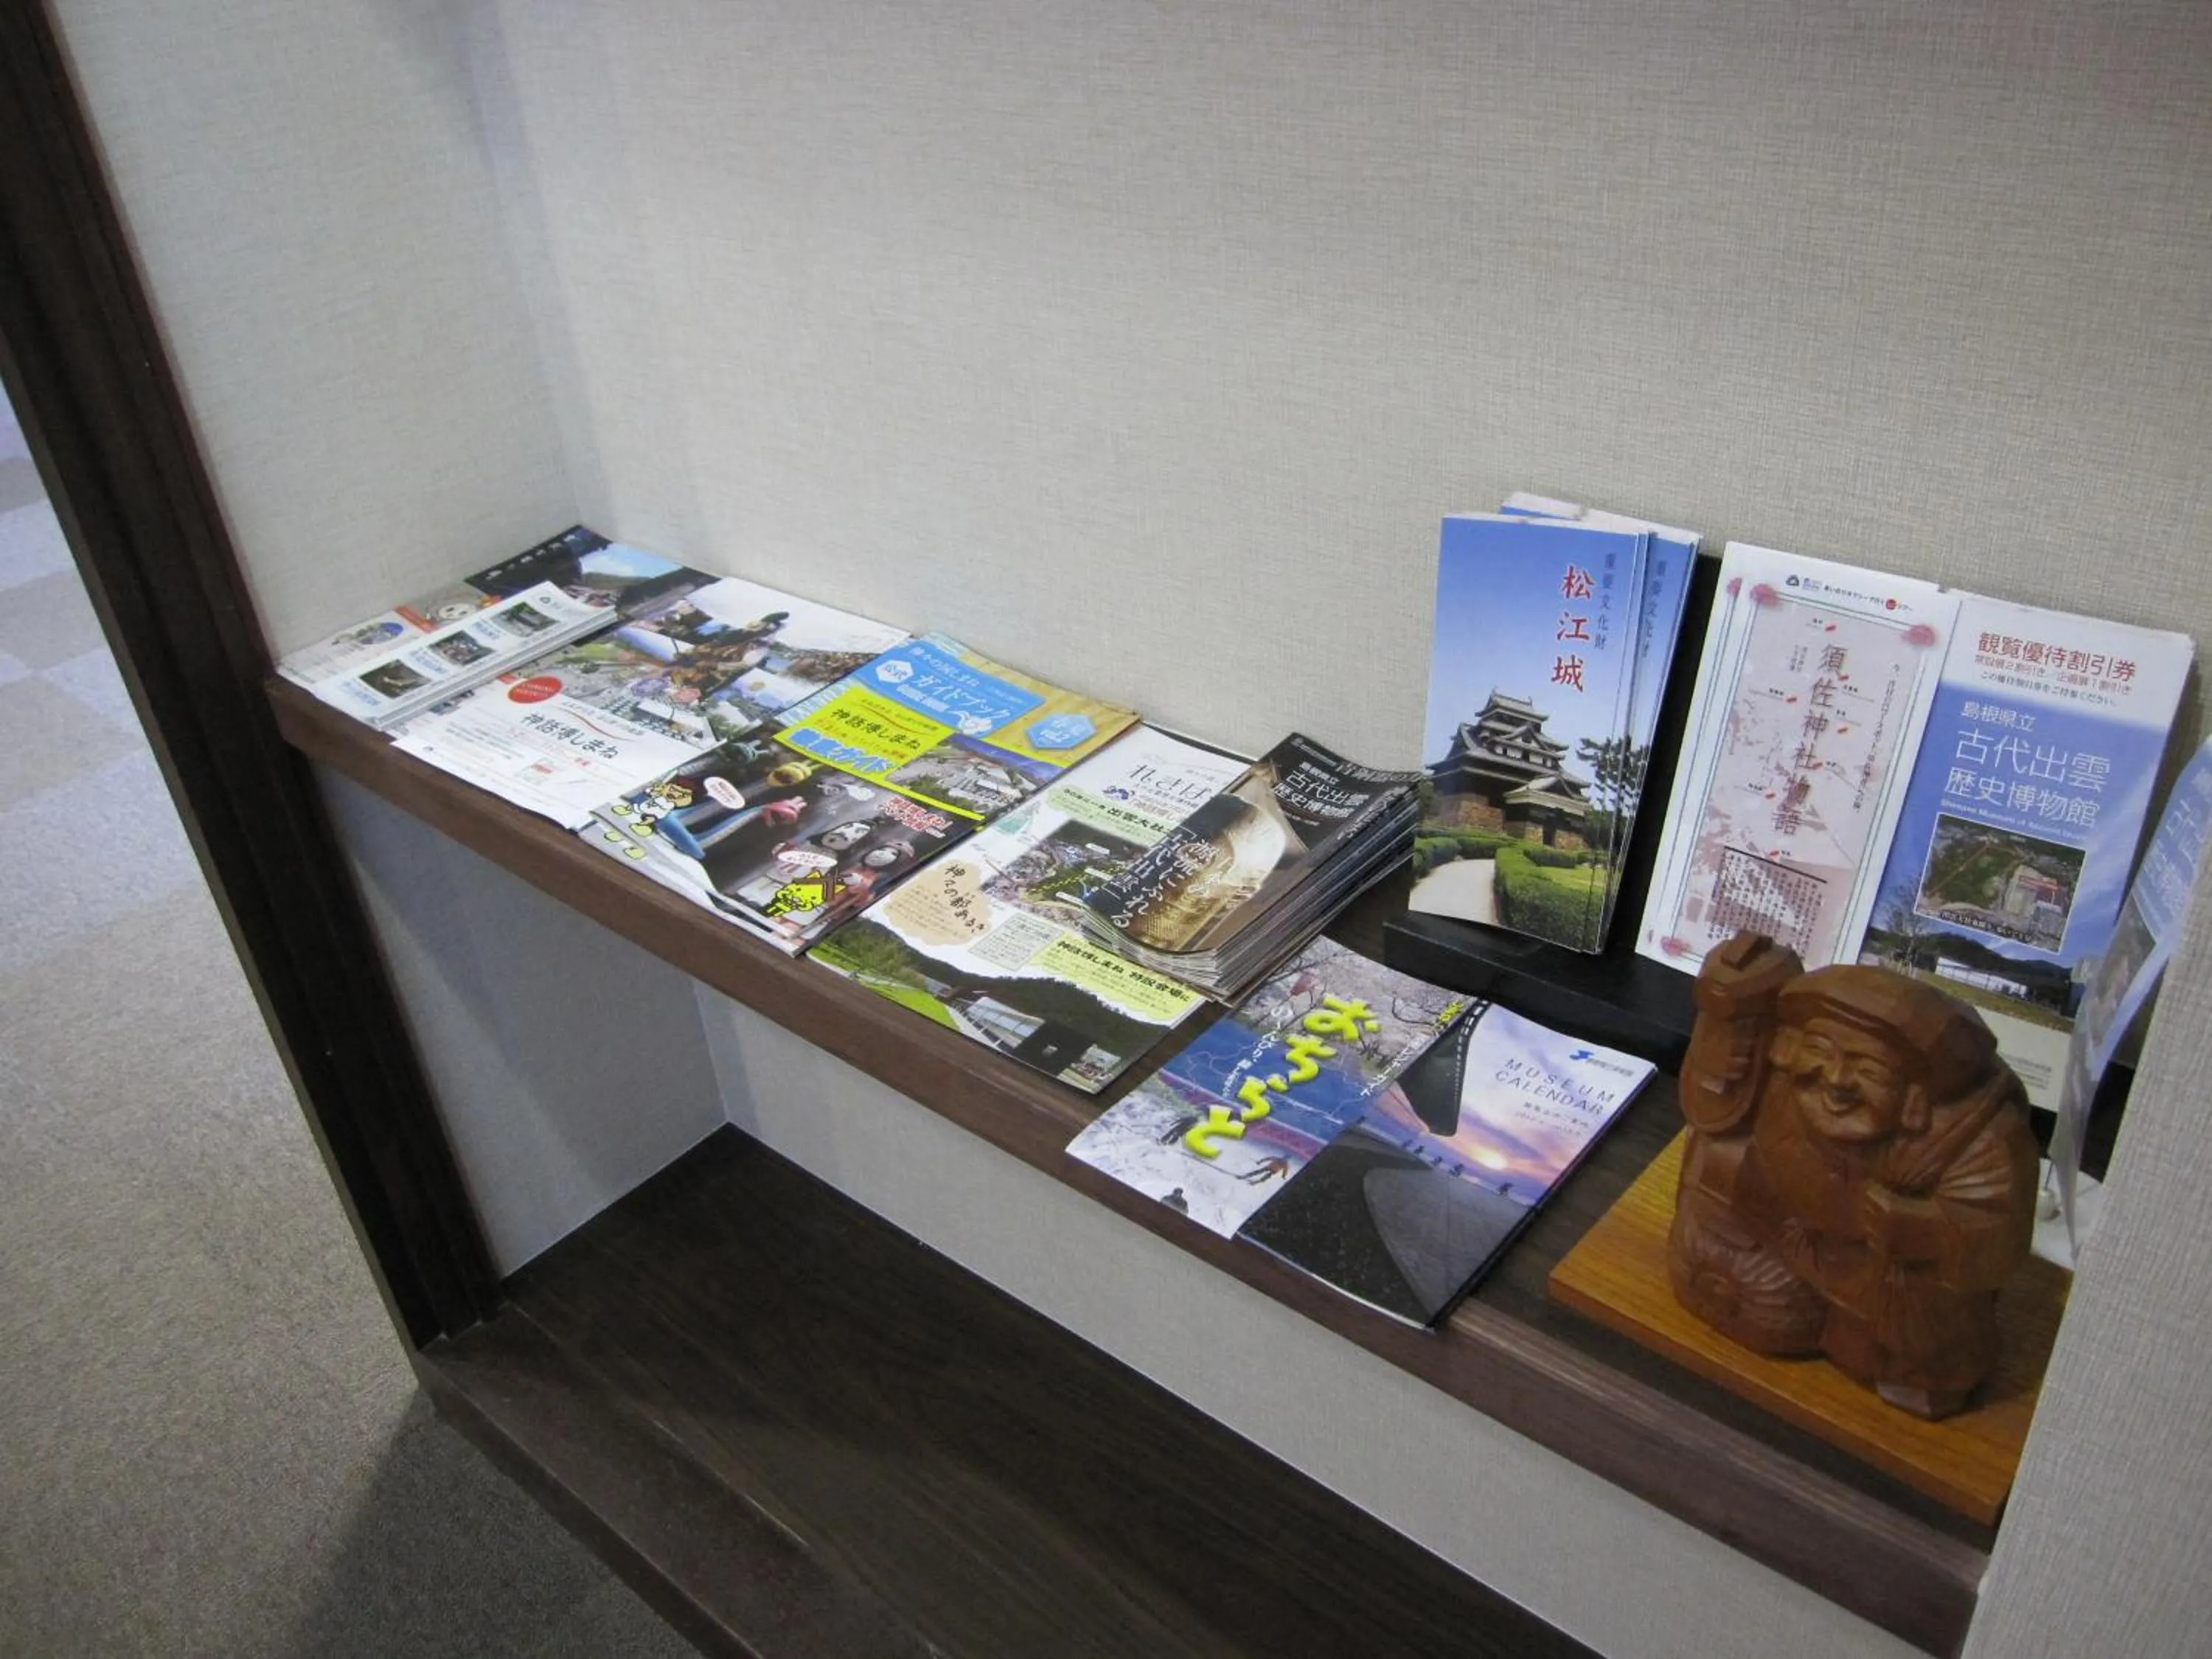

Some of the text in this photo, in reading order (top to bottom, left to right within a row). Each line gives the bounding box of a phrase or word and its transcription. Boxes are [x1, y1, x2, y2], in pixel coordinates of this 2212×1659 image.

[1551, 566, 1595, 693] 松江城
[1978, 632, 2136, 682] 観覧優待割引券
[911, 674, 1011, 720] ガイドブック
[1960, 700, 2037, 732] 島根県立
[1955, 727, 2112, 793] 古代出雲
[1943, 765, 2101, 830] 歴史博物館
[1495, 1069, 1604, 1116] CALENDAR
[1504, 1057, 1615, 1103] MUSEUM
